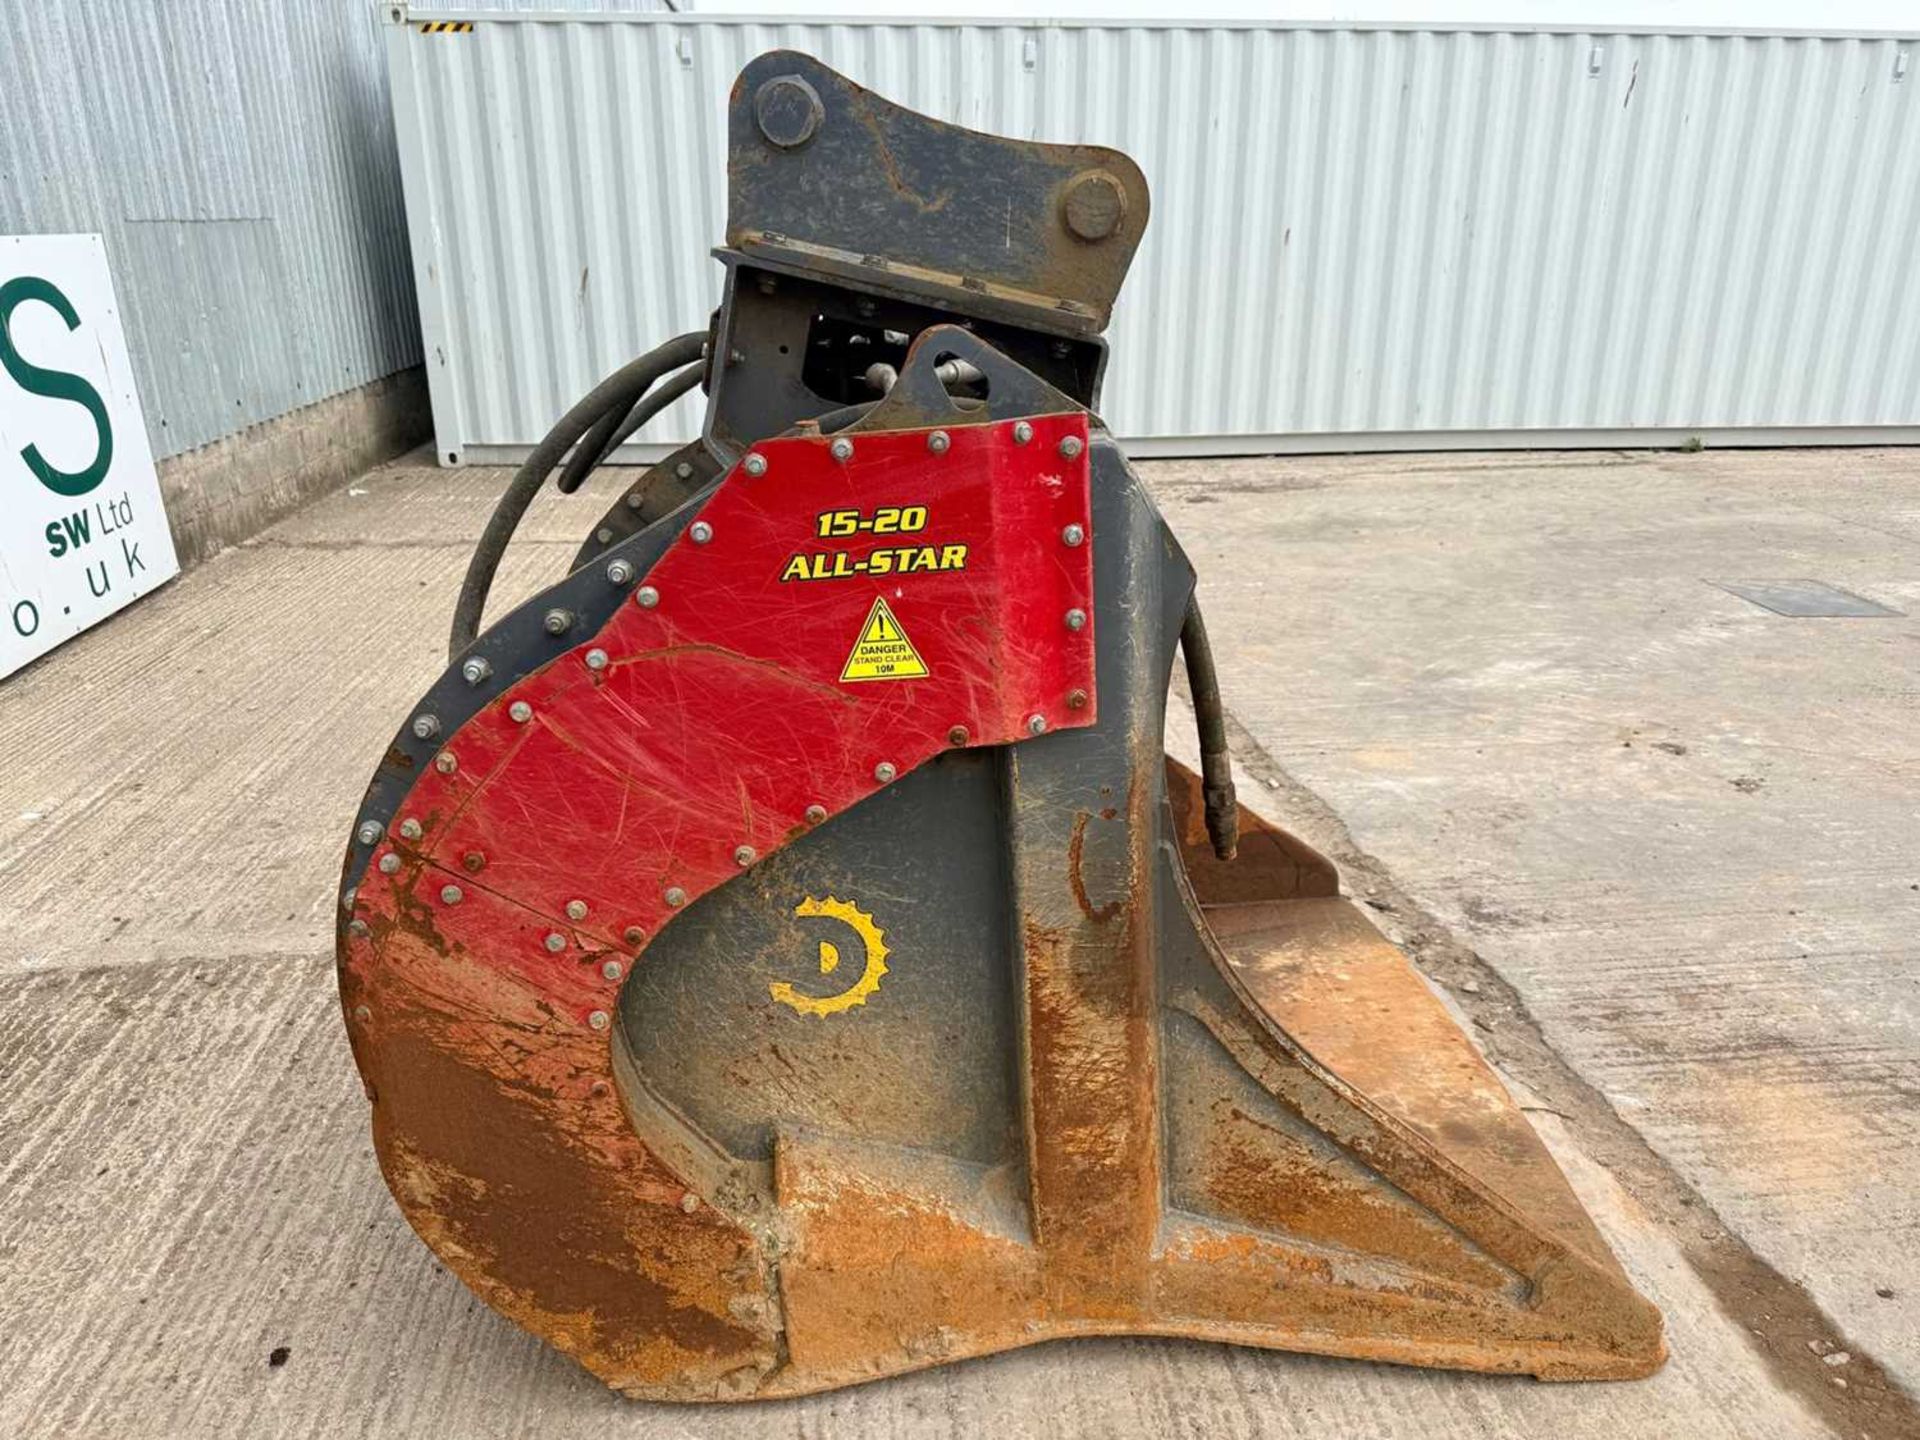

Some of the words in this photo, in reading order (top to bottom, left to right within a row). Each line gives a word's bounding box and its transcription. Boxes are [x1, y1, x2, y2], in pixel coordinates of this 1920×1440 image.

[45, 508, 91, 558] SW
[96, 491, 134, 535] Ltd
[817, 505, 928, 537] 15-20
[780, 544, 968, 582] ALL-STAR
[854, 656, 882, 665] STAND
[885, 654, 915, 663] CLEAR
[860, 644, 907, 655] DANGER
[875, 664, 895, 673] 10M
